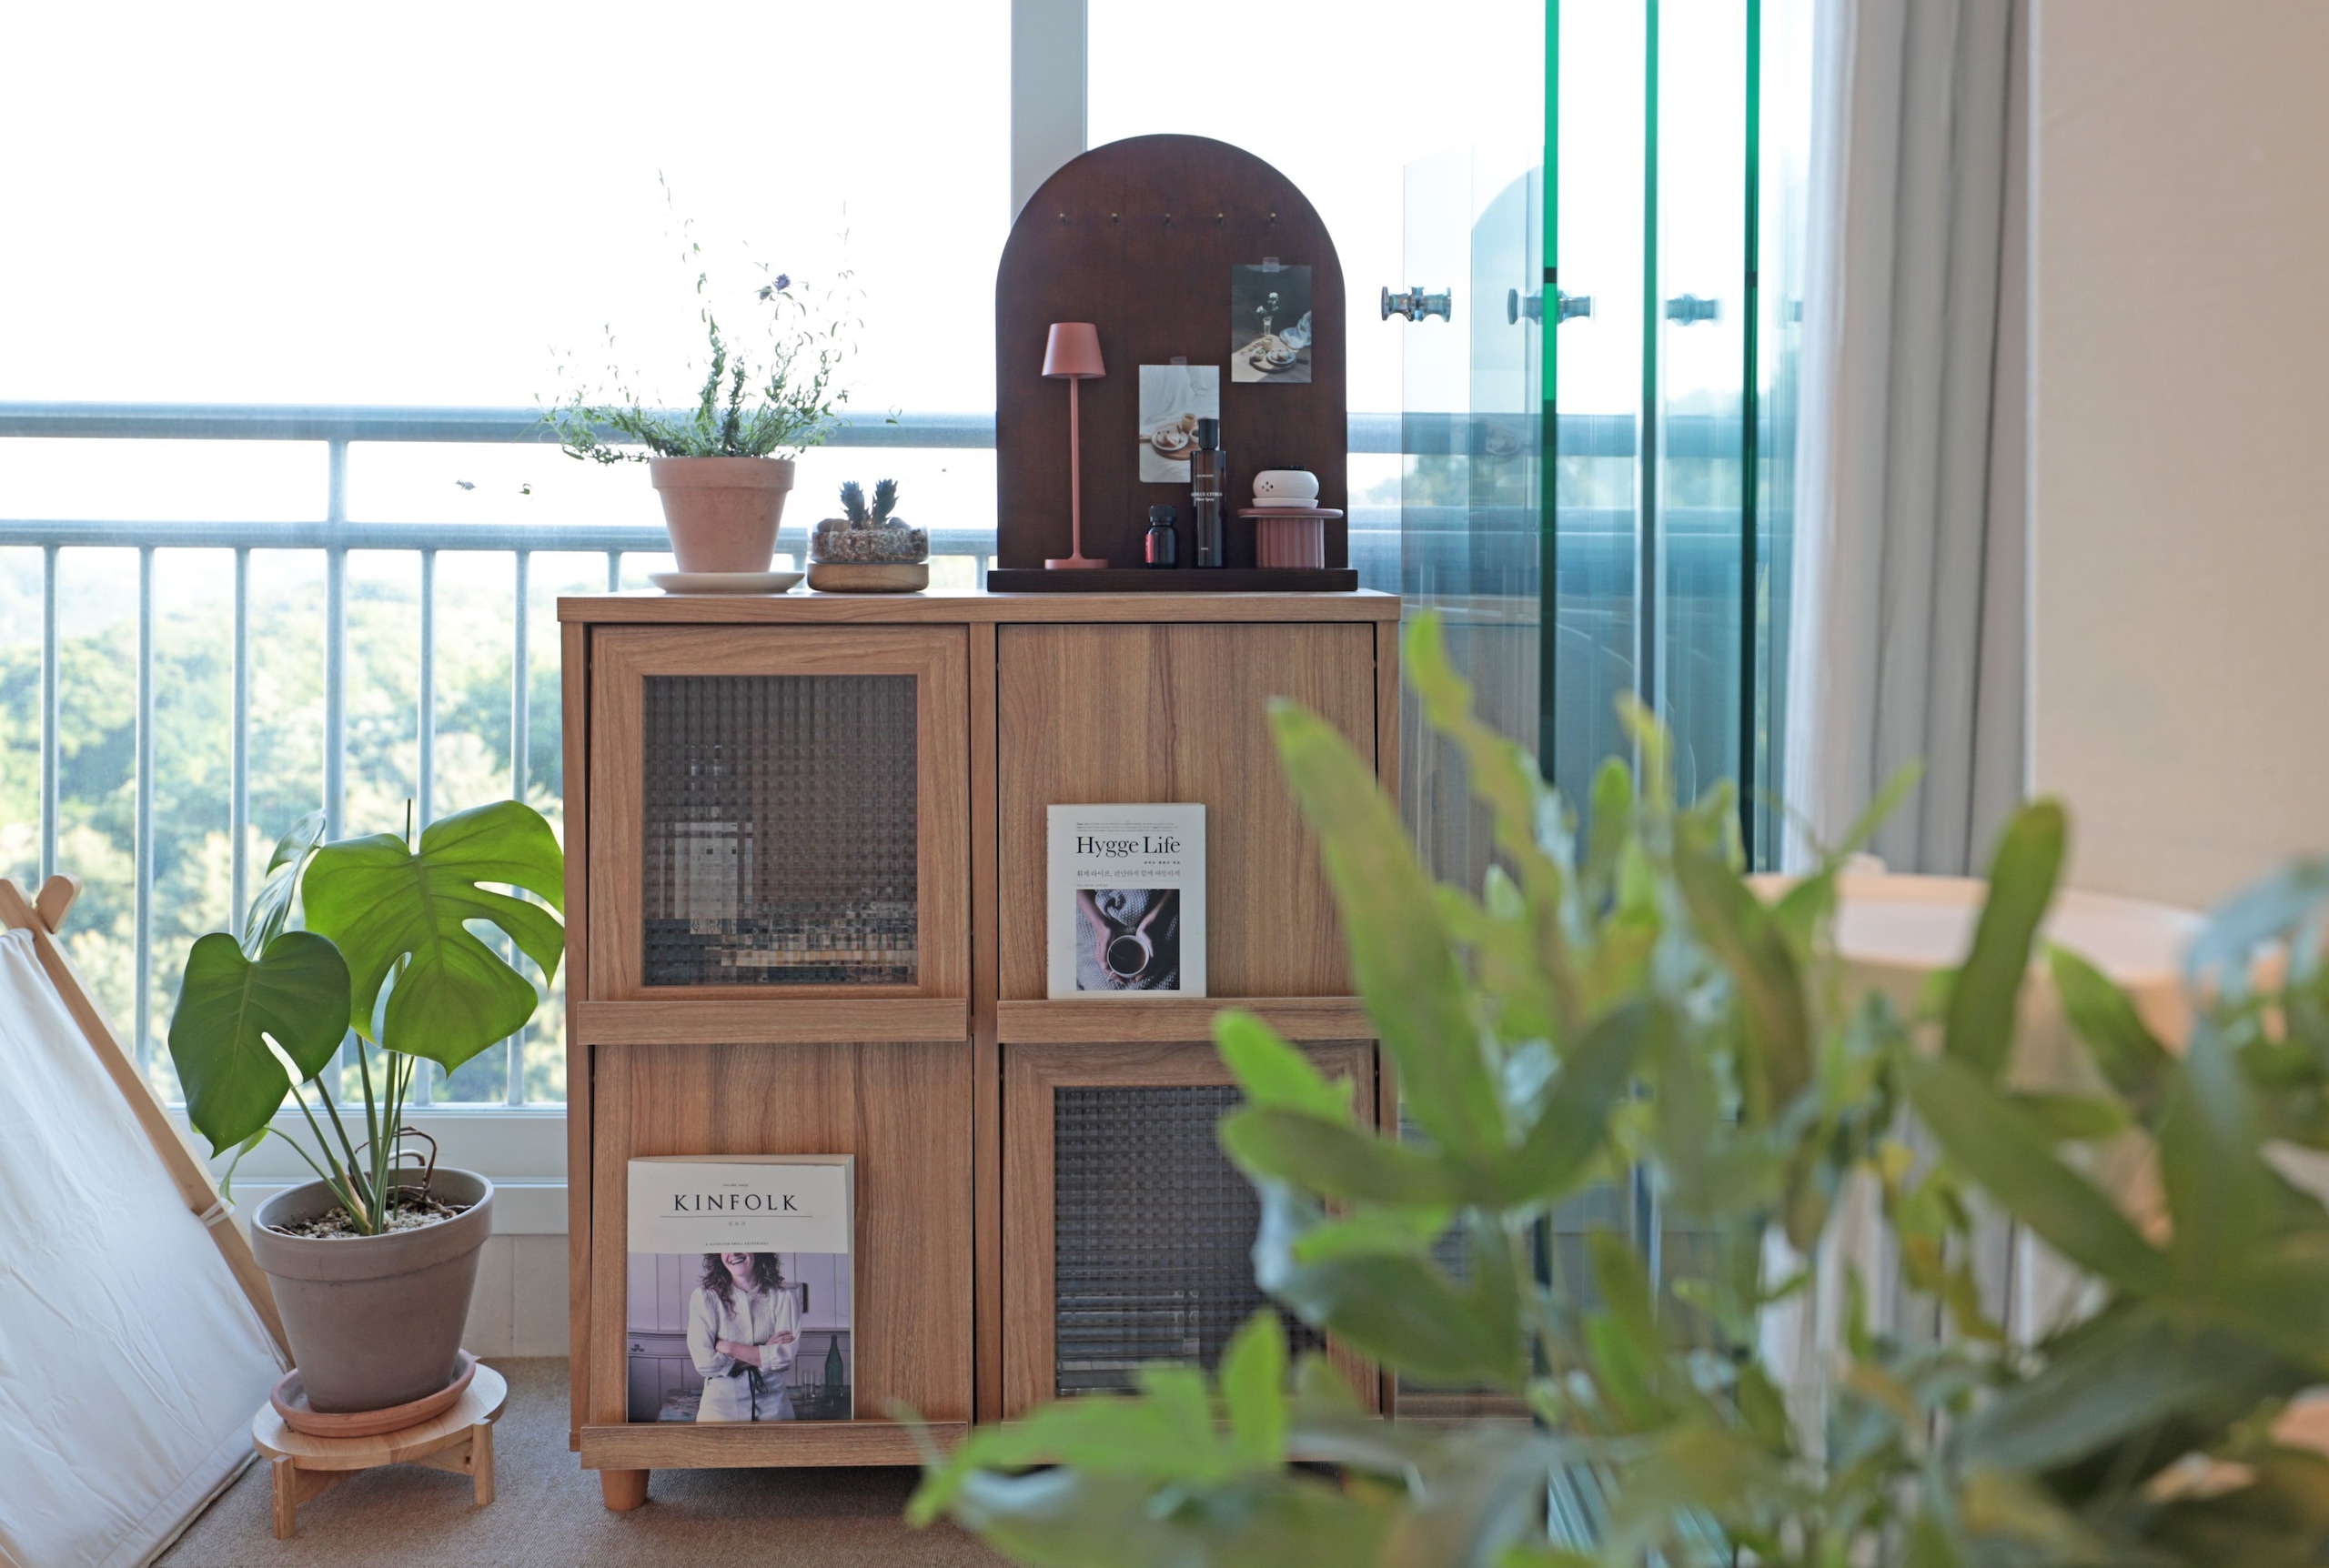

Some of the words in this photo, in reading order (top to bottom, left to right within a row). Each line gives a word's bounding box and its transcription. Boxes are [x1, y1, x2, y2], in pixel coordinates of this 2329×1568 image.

[1076, 836, 1139, 858] Hygge
[1143, 836, 1181, 854] Life
[1077, 869, 1090, 878] 휘게
[1114, 869, 1139, 878] 편안하게
[674, 1194, 799, 1211] KINFOLK
